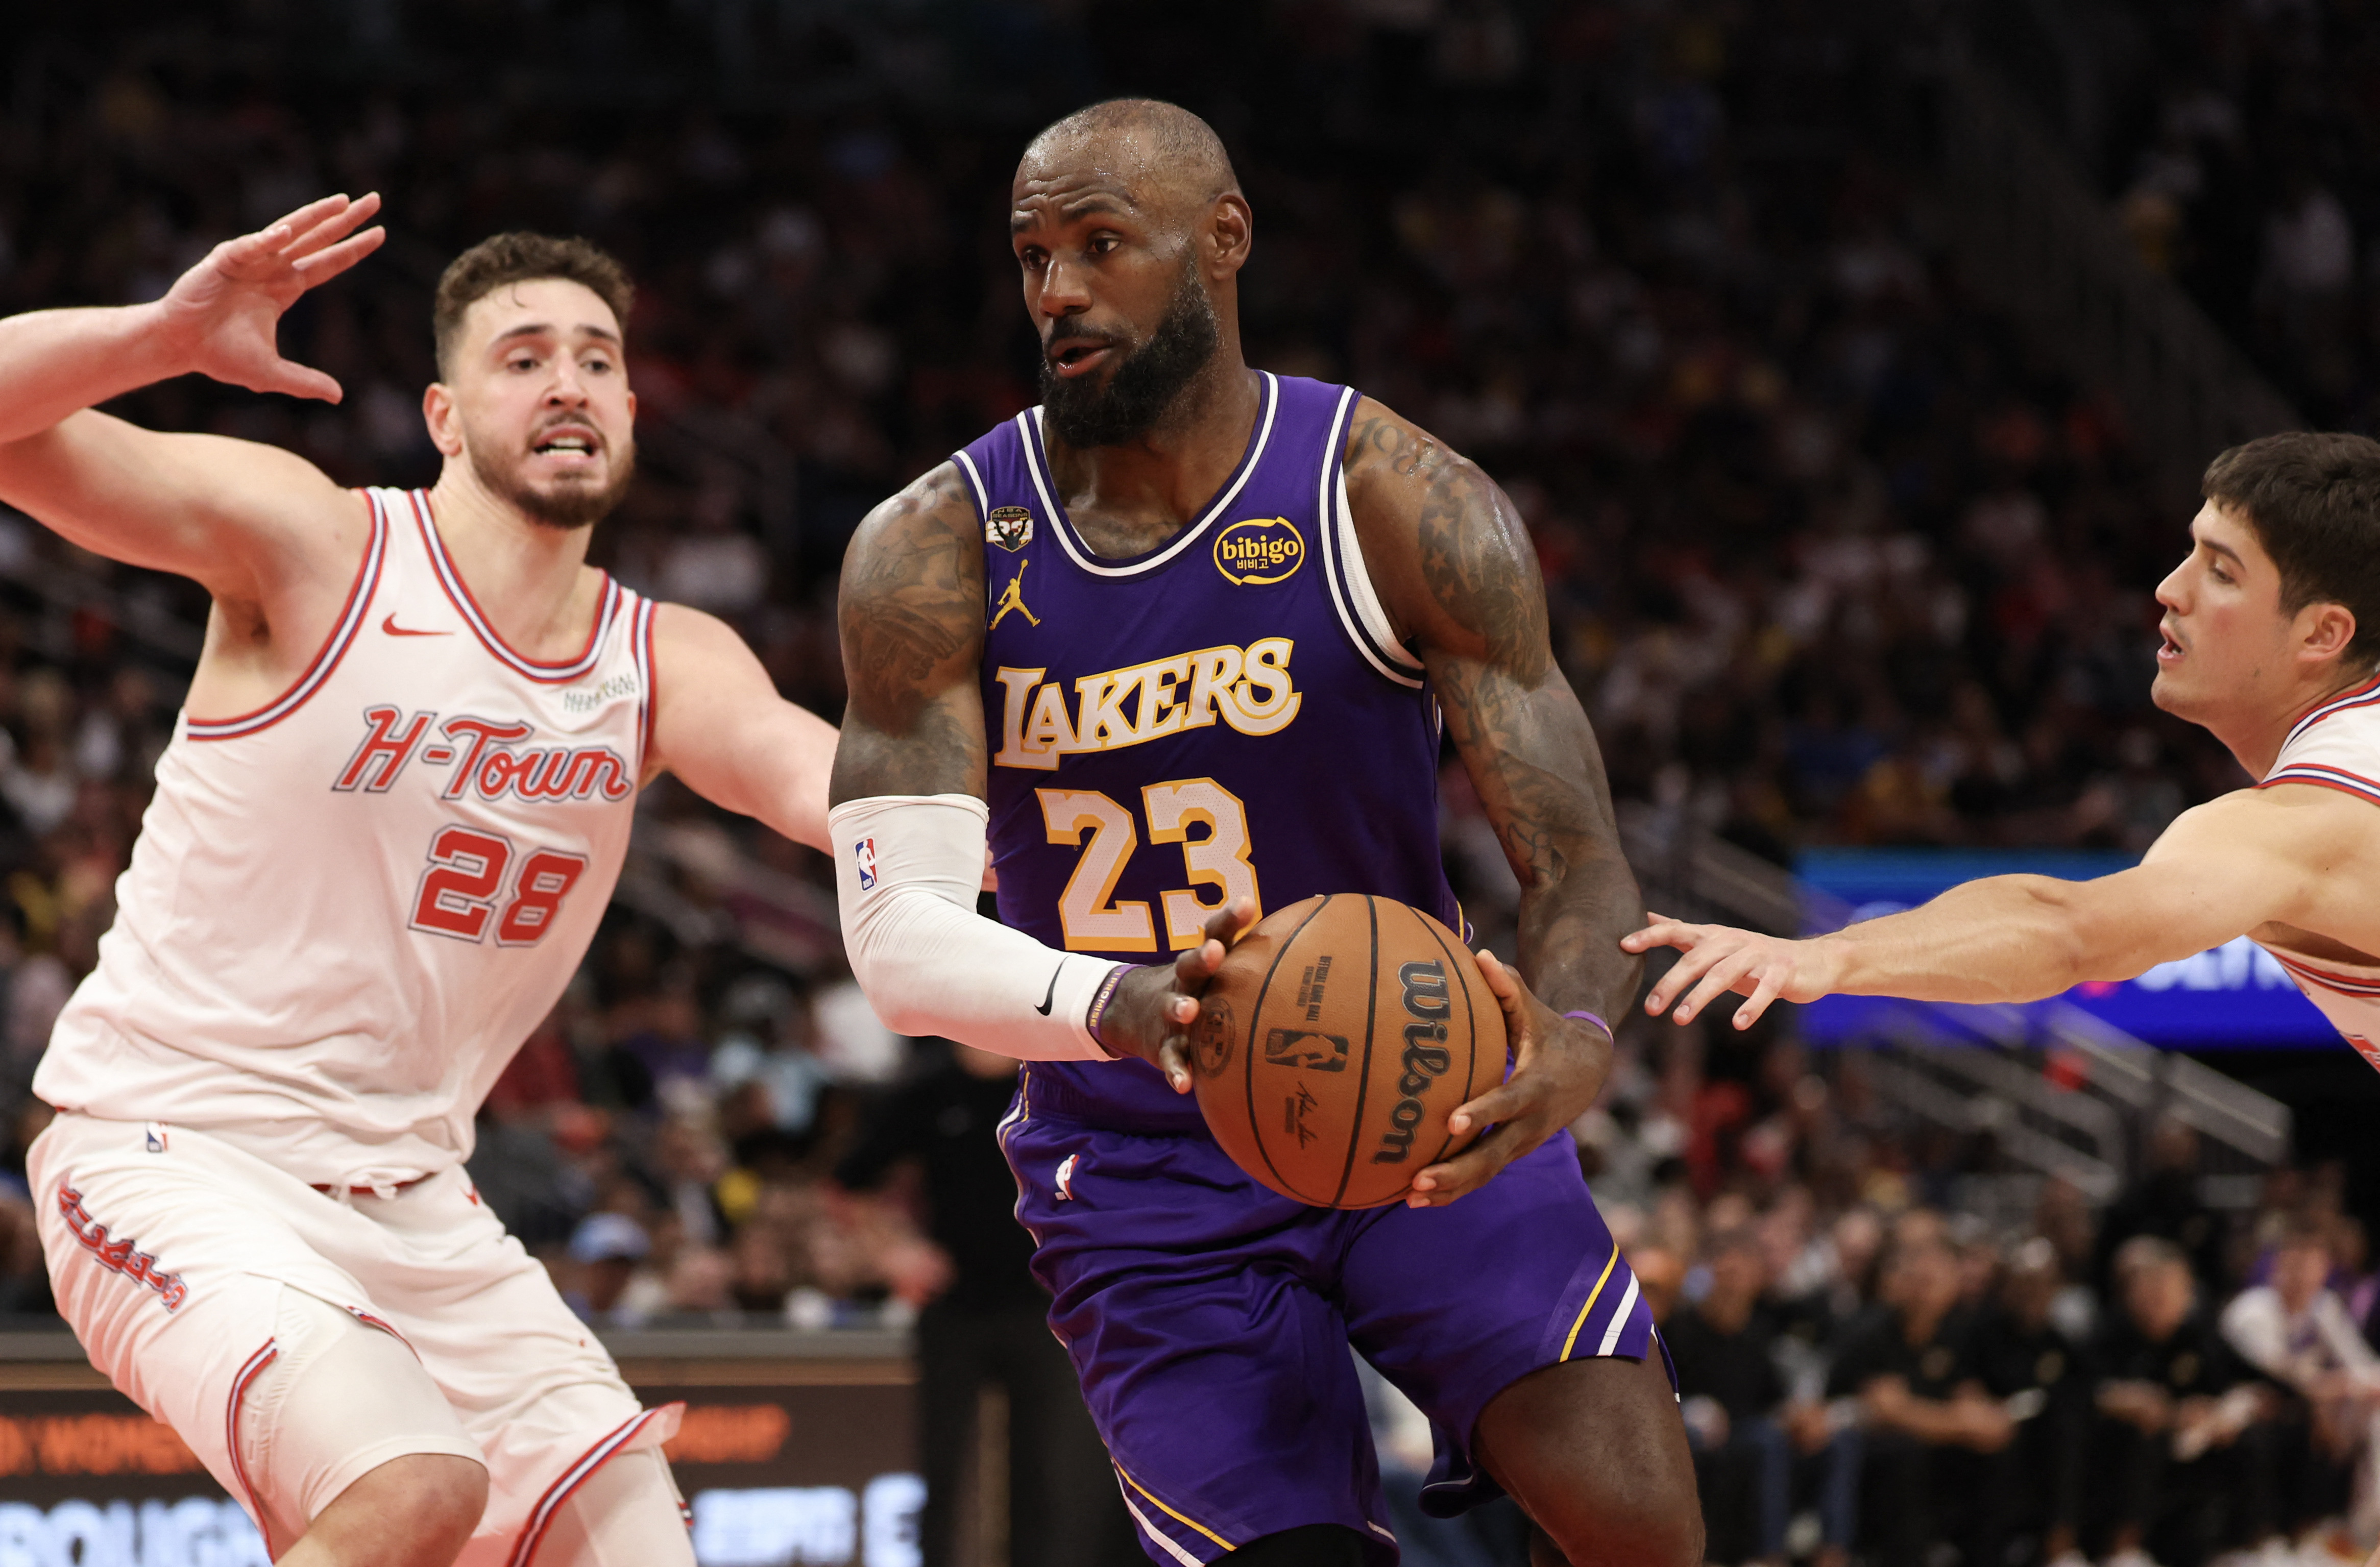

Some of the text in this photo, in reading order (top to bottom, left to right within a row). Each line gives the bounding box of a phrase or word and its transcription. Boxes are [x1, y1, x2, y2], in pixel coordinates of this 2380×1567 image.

[985, 519, 1034, 543] 23
[1222, 535, 1299, 564] bibigo
[1237, 558, 1269, 570] 비비고
[994, 637, 1302, 771] LAKERS
[331, 704, 633, 802] H-Town
[407, 824, 589, 947] 28
[863, 877, 873, 889] NBA
[1034, 777, 1262, 952] 23
[1090, 977, 1118, 1027] PROMISE
[1370, 959, 1451, 1165] Wilson
